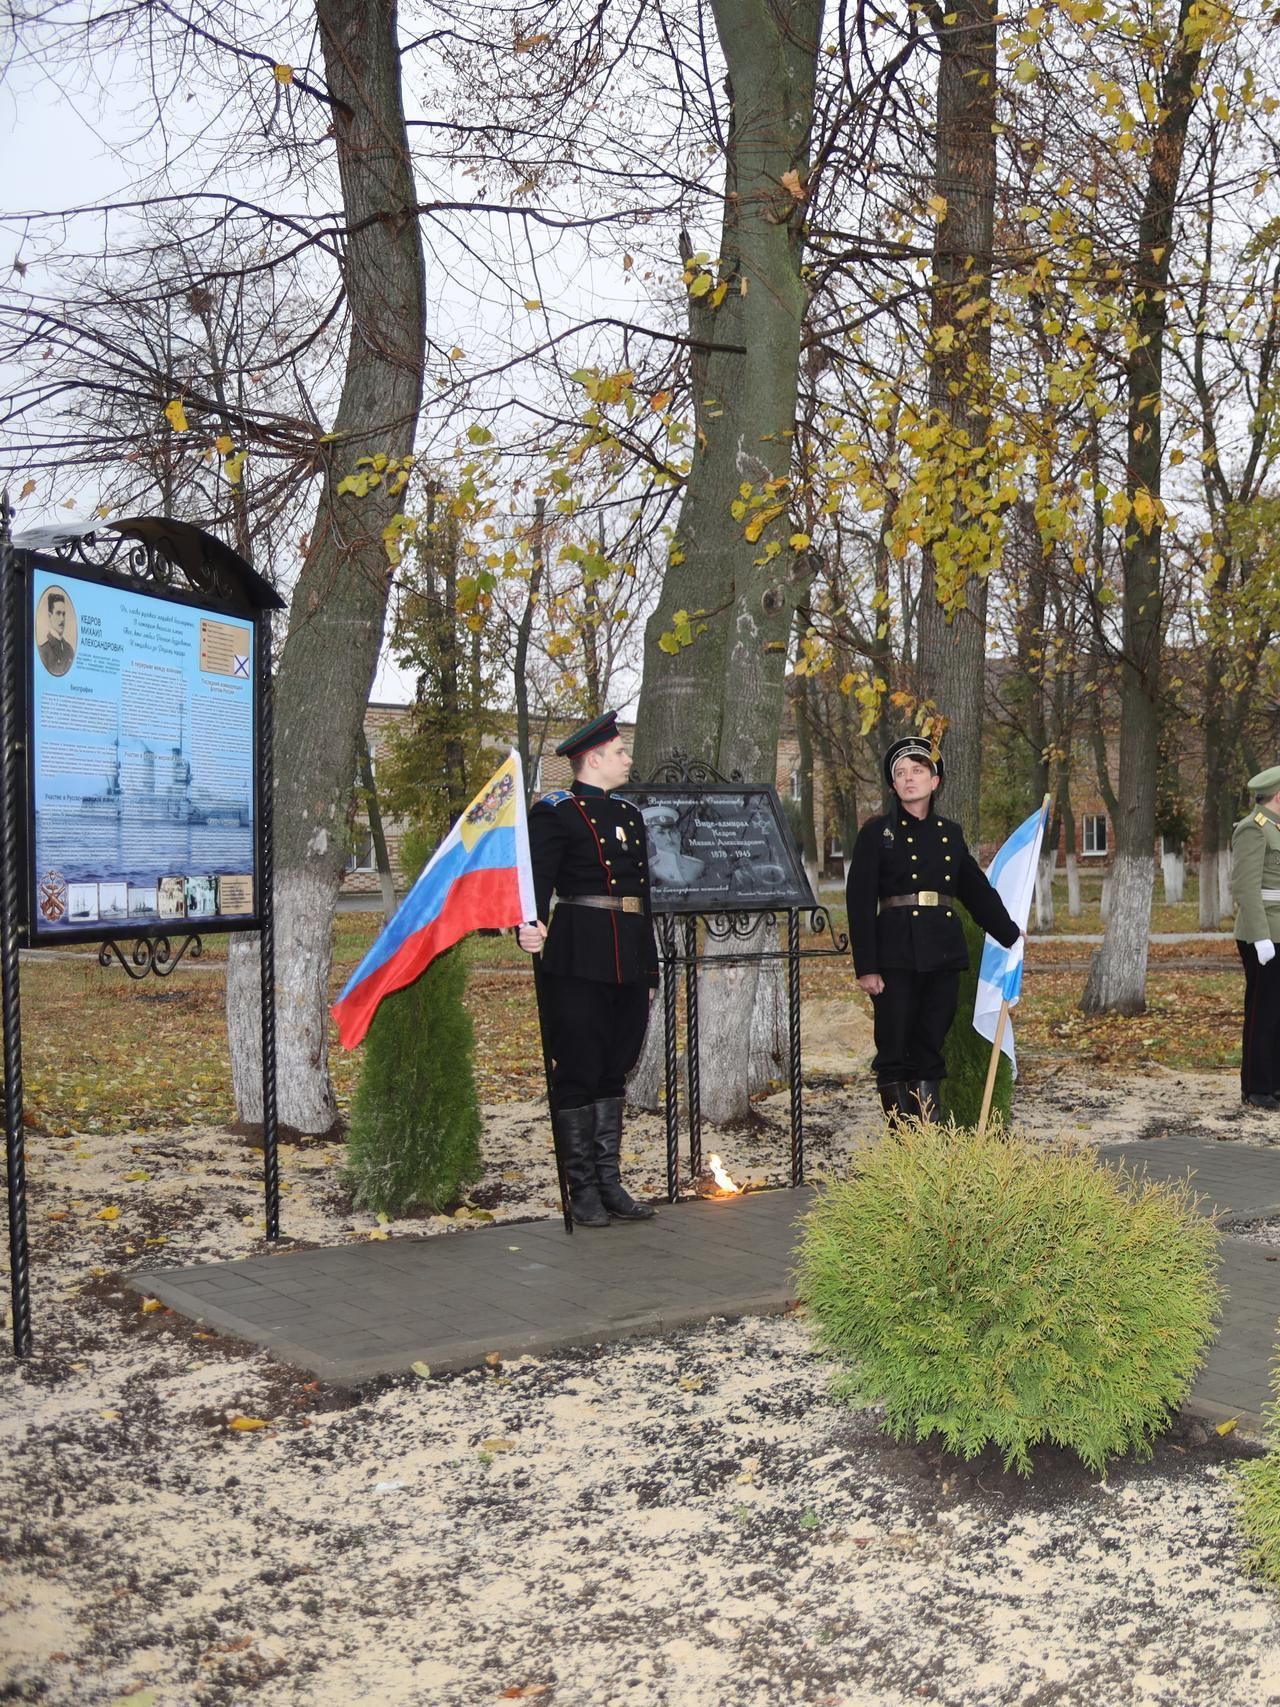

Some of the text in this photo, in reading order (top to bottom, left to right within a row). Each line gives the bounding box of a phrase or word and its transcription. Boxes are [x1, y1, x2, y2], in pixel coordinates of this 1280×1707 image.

[80, 615, 101, 626] КЕДРОВ
[80, 626, 103, 638] МИХАИЛ
[80, 637, 124, 653] АЛЕКСАНДРОВИЧ
[694, 818, 749, 829] Вице-адмирал
[712, 829, 737, 838] Кедров
[688, 838, 766, 847] Михаил Александрович
[711, 850, 728, 858] 1878
[735, 850, 751, 858] 1945
